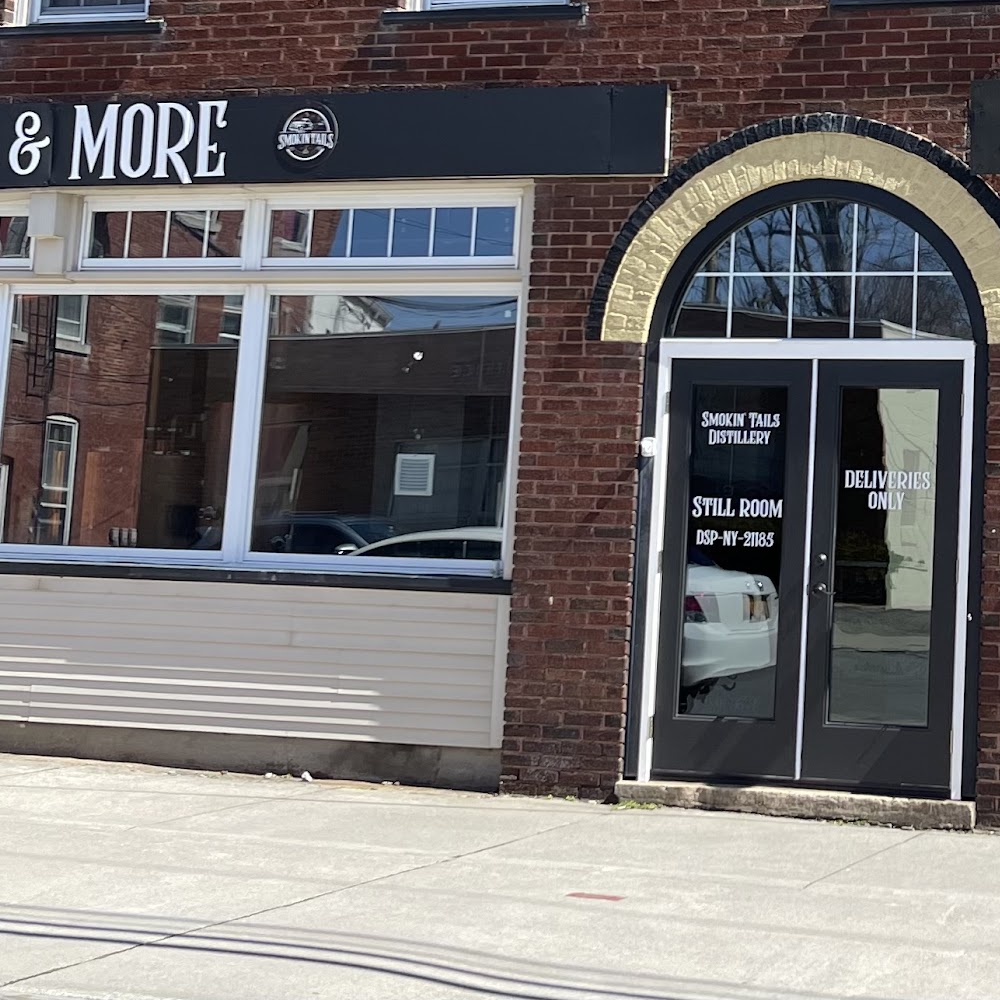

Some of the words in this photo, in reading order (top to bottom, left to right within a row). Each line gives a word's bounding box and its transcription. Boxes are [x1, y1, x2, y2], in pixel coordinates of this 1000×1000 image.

[8, 111, 51, 176] &
[67, 100, 229, 184] MORE
[748, 411, 781, 429] TAILS
[708, 428, 772, 445] DISTILLERY
[844, 469, 932, 490] DELIVERIES
[691, 495, 736, 518] STILL
[739, 497, 784, 519] ROOM
[868, 490, 905, 511] ONLY
[696, 529, 775, 547] DSP-NY-21185
